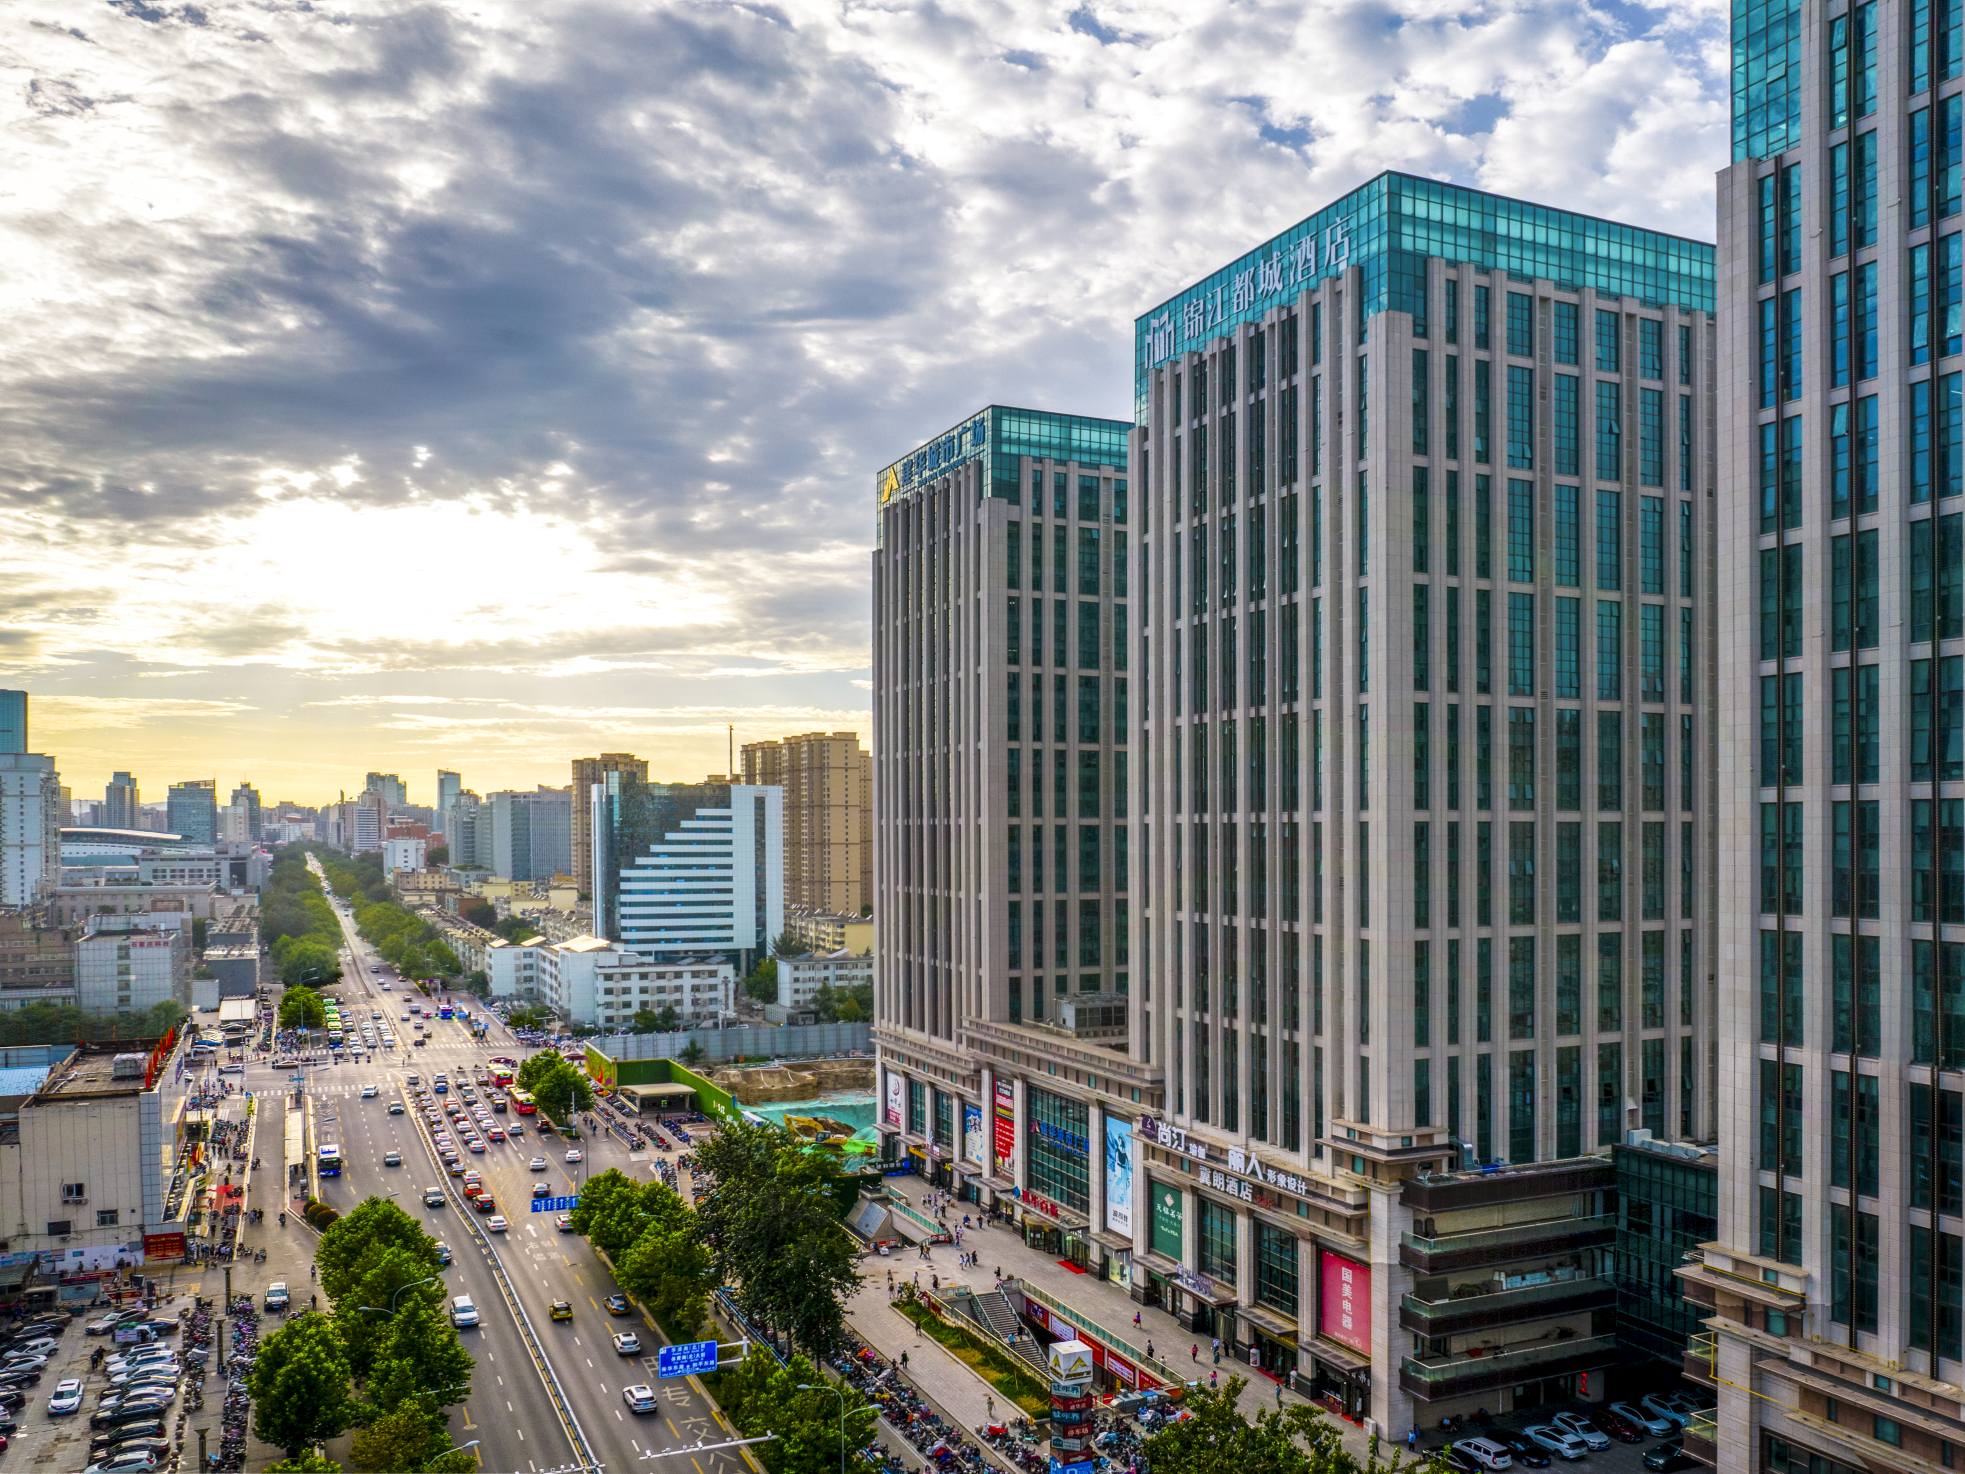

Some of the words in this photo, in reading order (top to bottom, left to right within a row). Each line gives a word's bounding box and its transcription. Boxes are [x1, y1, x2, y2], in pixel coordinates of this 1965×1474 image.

[1183, 215, 1355, 341] 锦江都城酒店
[901, 416, 986, 487] 建华城市广场
[1157, 1121, 1187, 1152] 尚汀
[1228, 1144, 1264, 1180] 丽人
[1266, 1168, 1308, 1196] 形象设计
[1341, 1266, 1353, 1331] 国美电器
